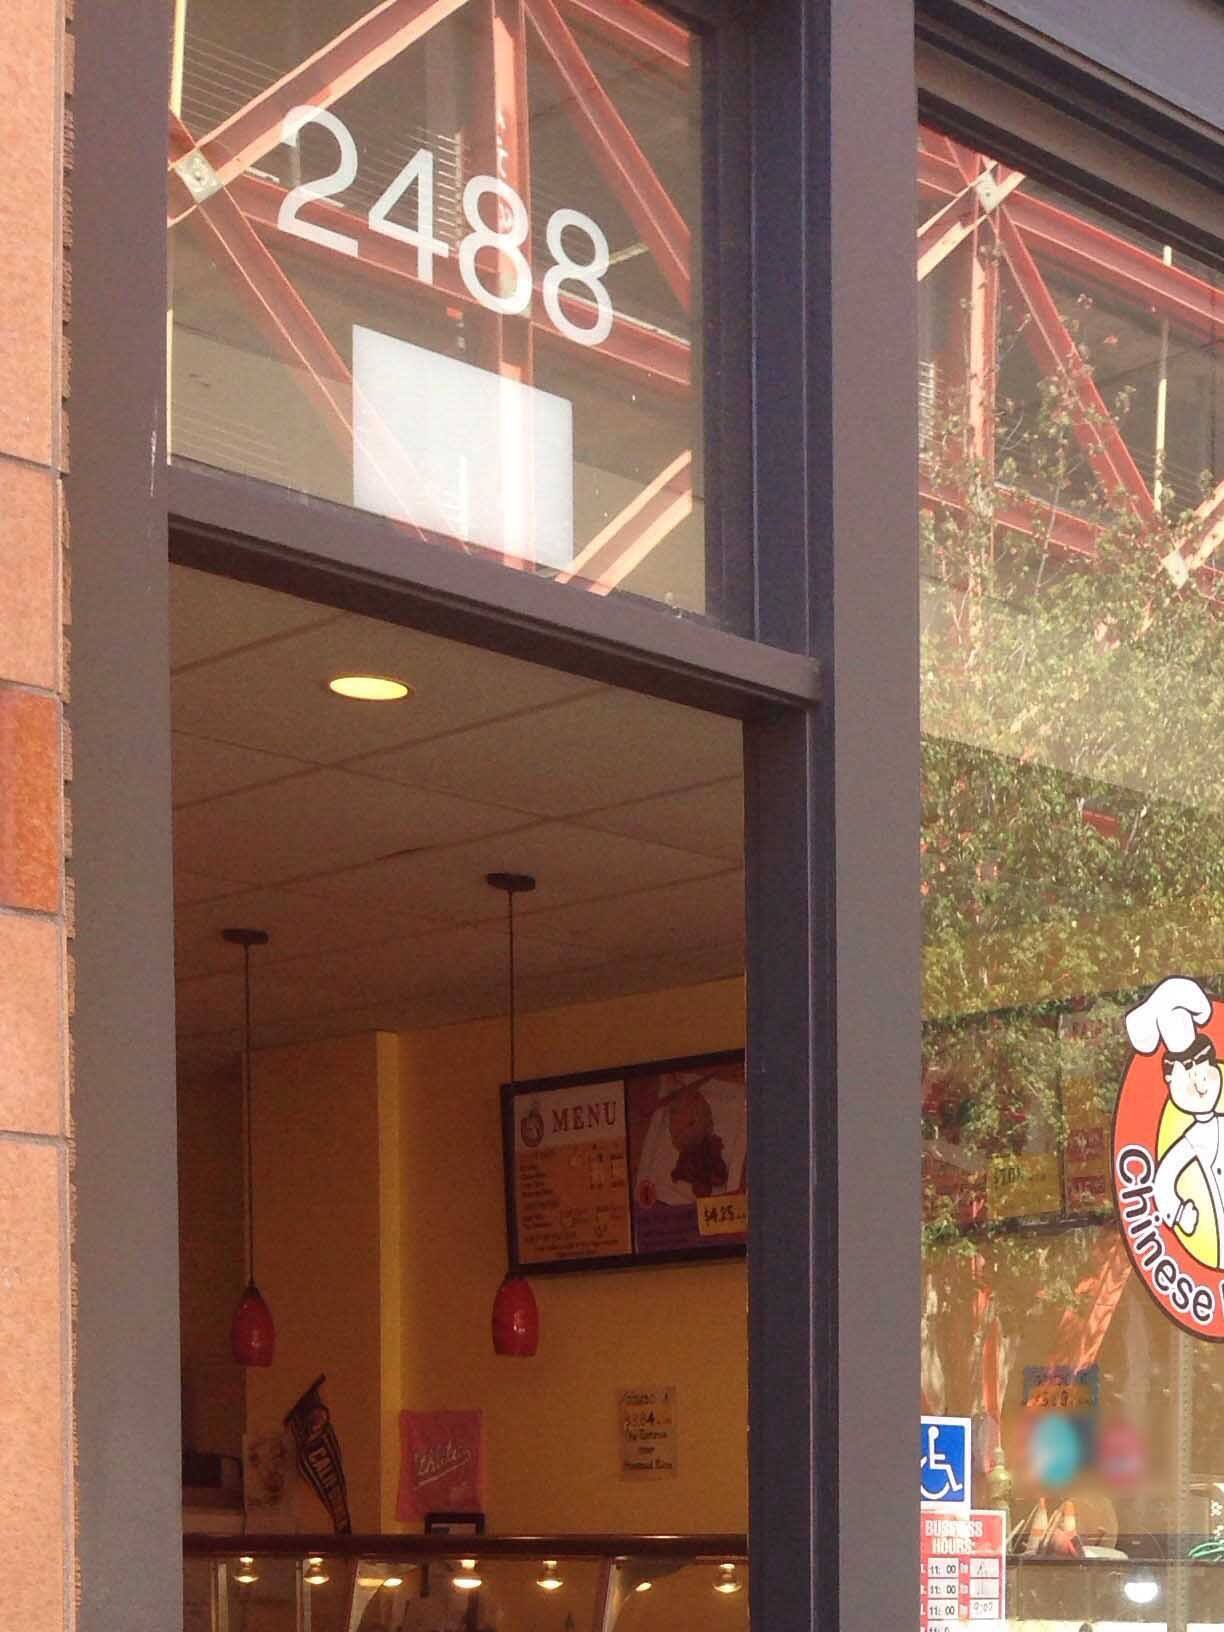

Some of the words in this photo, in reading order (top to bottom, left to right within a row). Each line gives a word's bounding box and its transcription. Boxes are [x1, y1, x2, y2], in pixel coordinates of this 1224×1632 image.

[277, 104, 614, 347] 2488
[552, 1101, 617, 1134] MENU
[1118, 1148, 1214, 1322] Chinese
